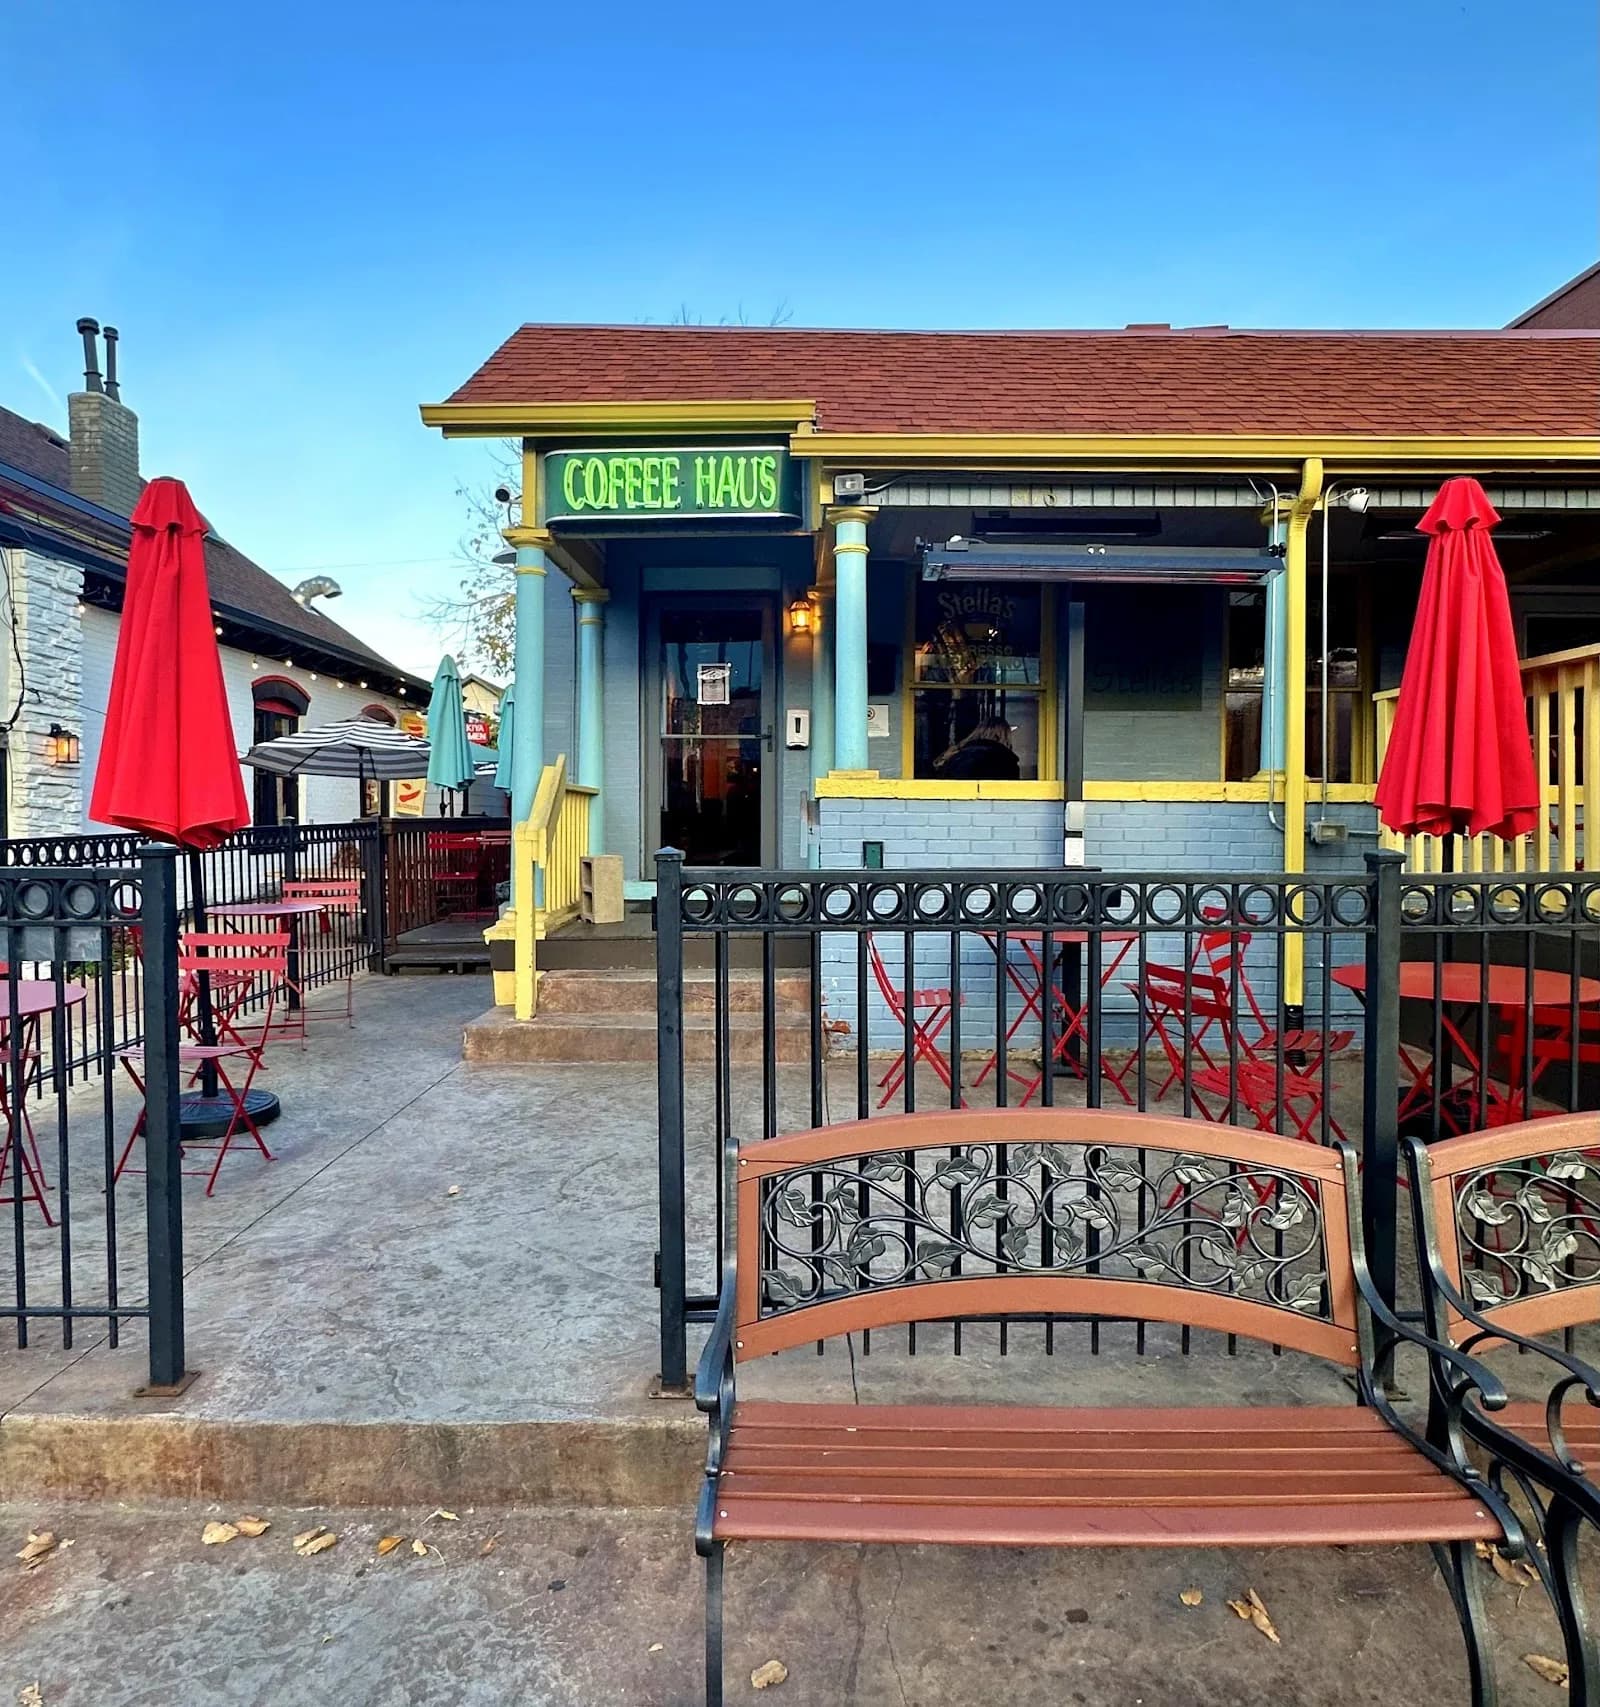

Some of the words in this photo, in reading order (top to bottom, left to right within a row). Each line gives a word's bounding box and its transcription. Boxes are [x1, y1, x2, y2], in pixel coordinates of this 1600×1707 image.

[564, 457, 681, 511] COFFEE
[695, 455, 777, 508] HAUS
[937, 587, 1017, 619] Stella's
